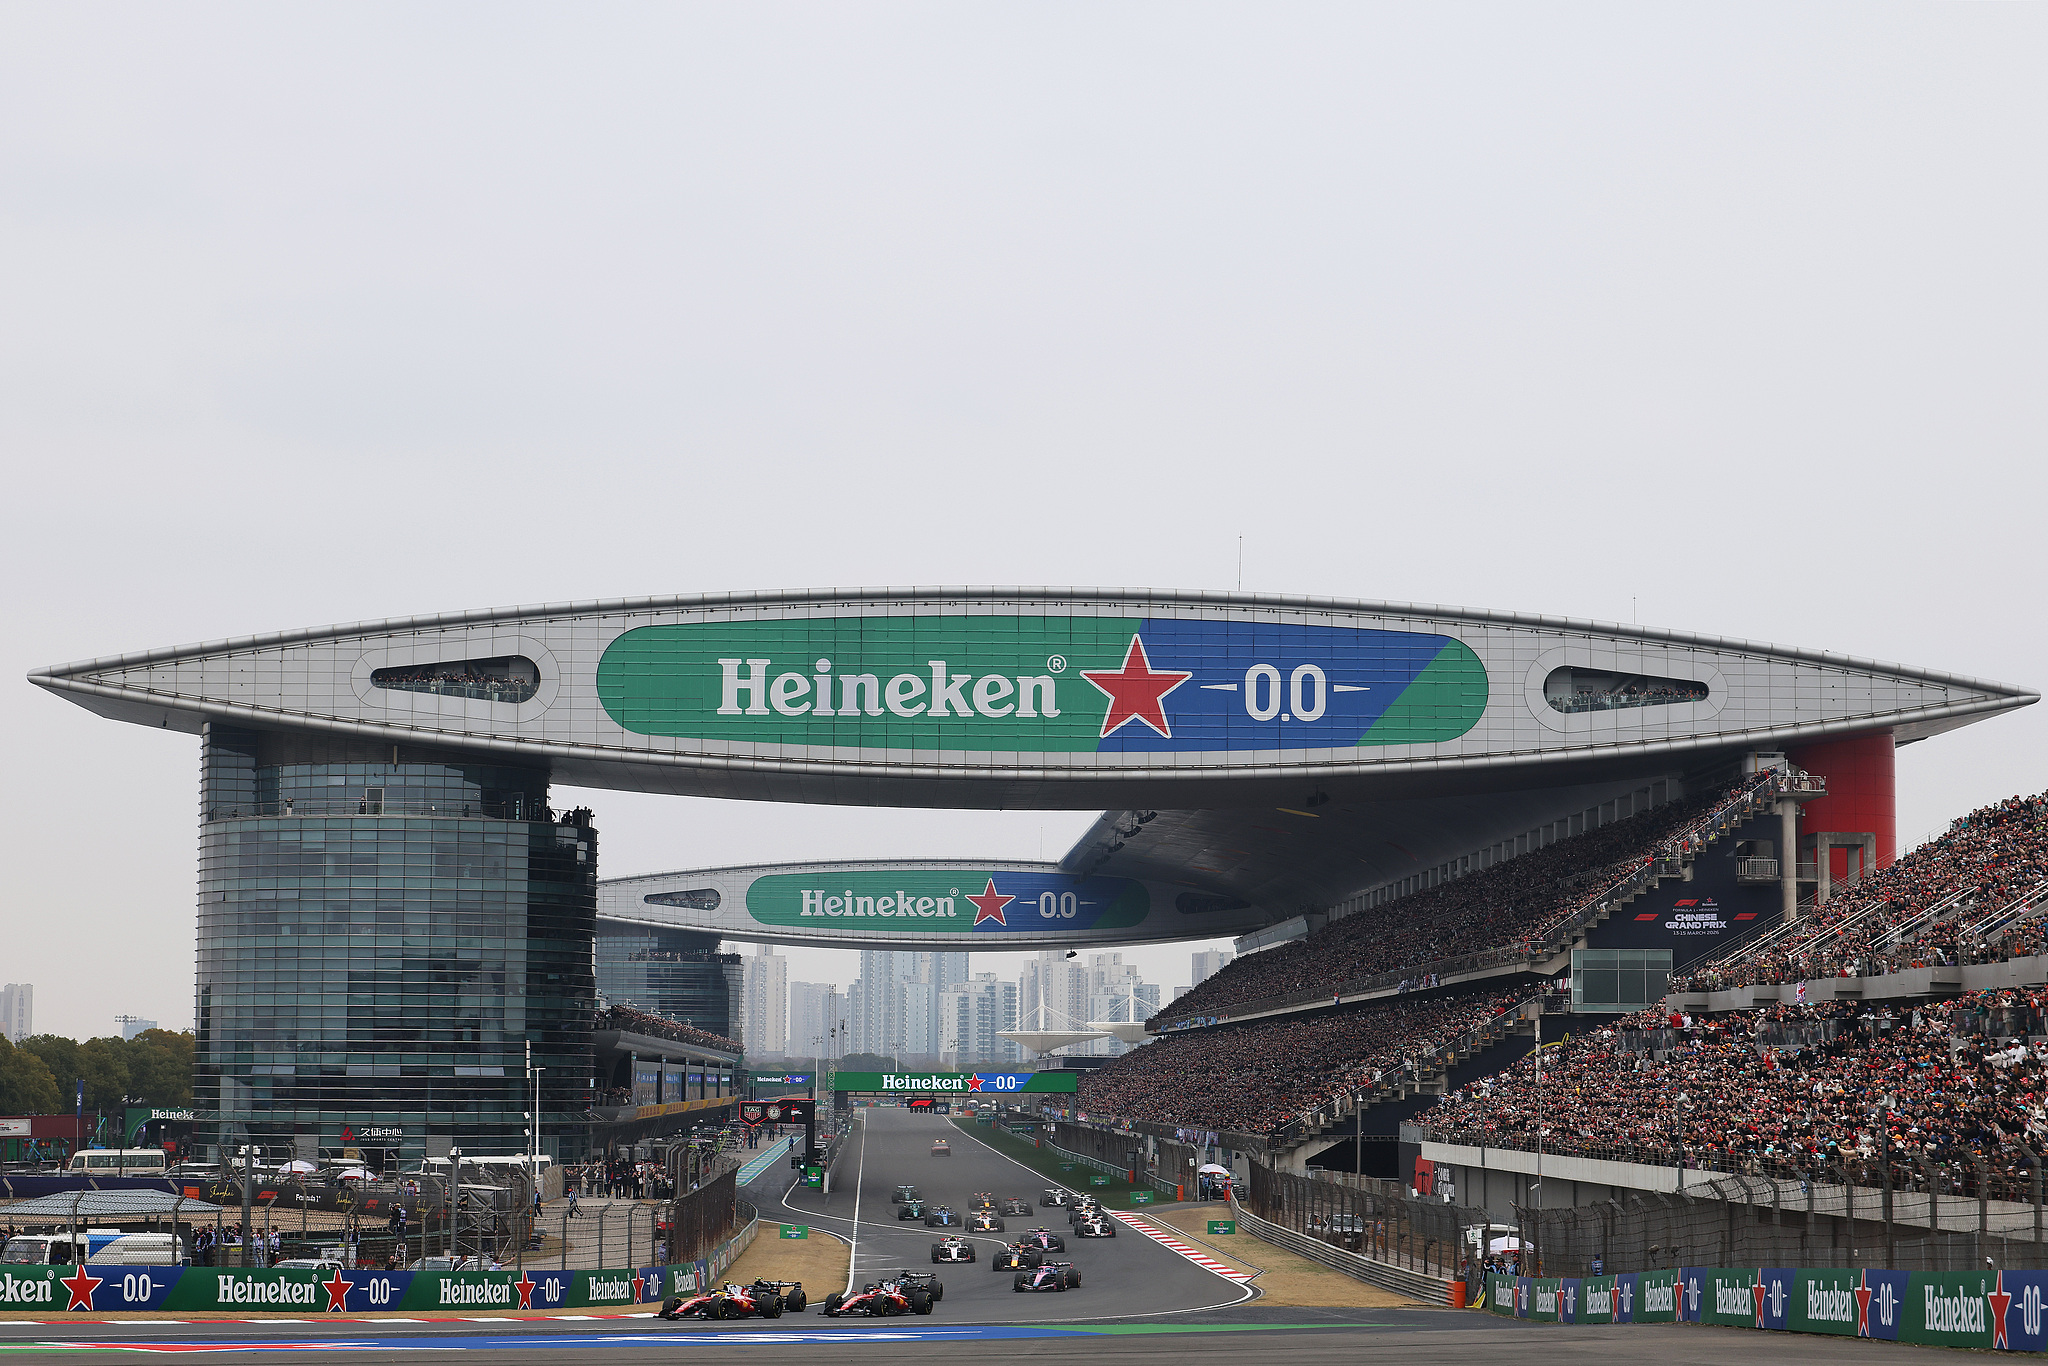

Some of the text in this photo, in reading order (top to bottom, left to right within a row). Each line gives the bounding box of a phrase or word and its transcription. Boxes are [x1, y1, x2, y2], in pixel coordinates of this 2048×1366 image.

[716, 657, 1329, 722] Heineken 0.0
[800, 889, 957, 918] Heineken
[1674, 913, 1718, 921] CHINESE
[1665, 921, 1727, 929] GRAND PRIX
[881, 1075, 1016, 1090] Heineken 0.0
[123, 1273, 152, 1303] 0.0
[217, 1274, 391, 1305] Heineken 0.0
[439, 1277, 560, 1305] Heineken 0.0
[588, 1275, 630, 1301] Heineken
[1645, 1279, 1674, 1313] Heineken
[1715, 1278, 1752, 1316] Heineken
[1807, 1279, 1893, 1327] Heineken 0.0
[1924, 1284, 2041, 1336] Heineken 0.0
